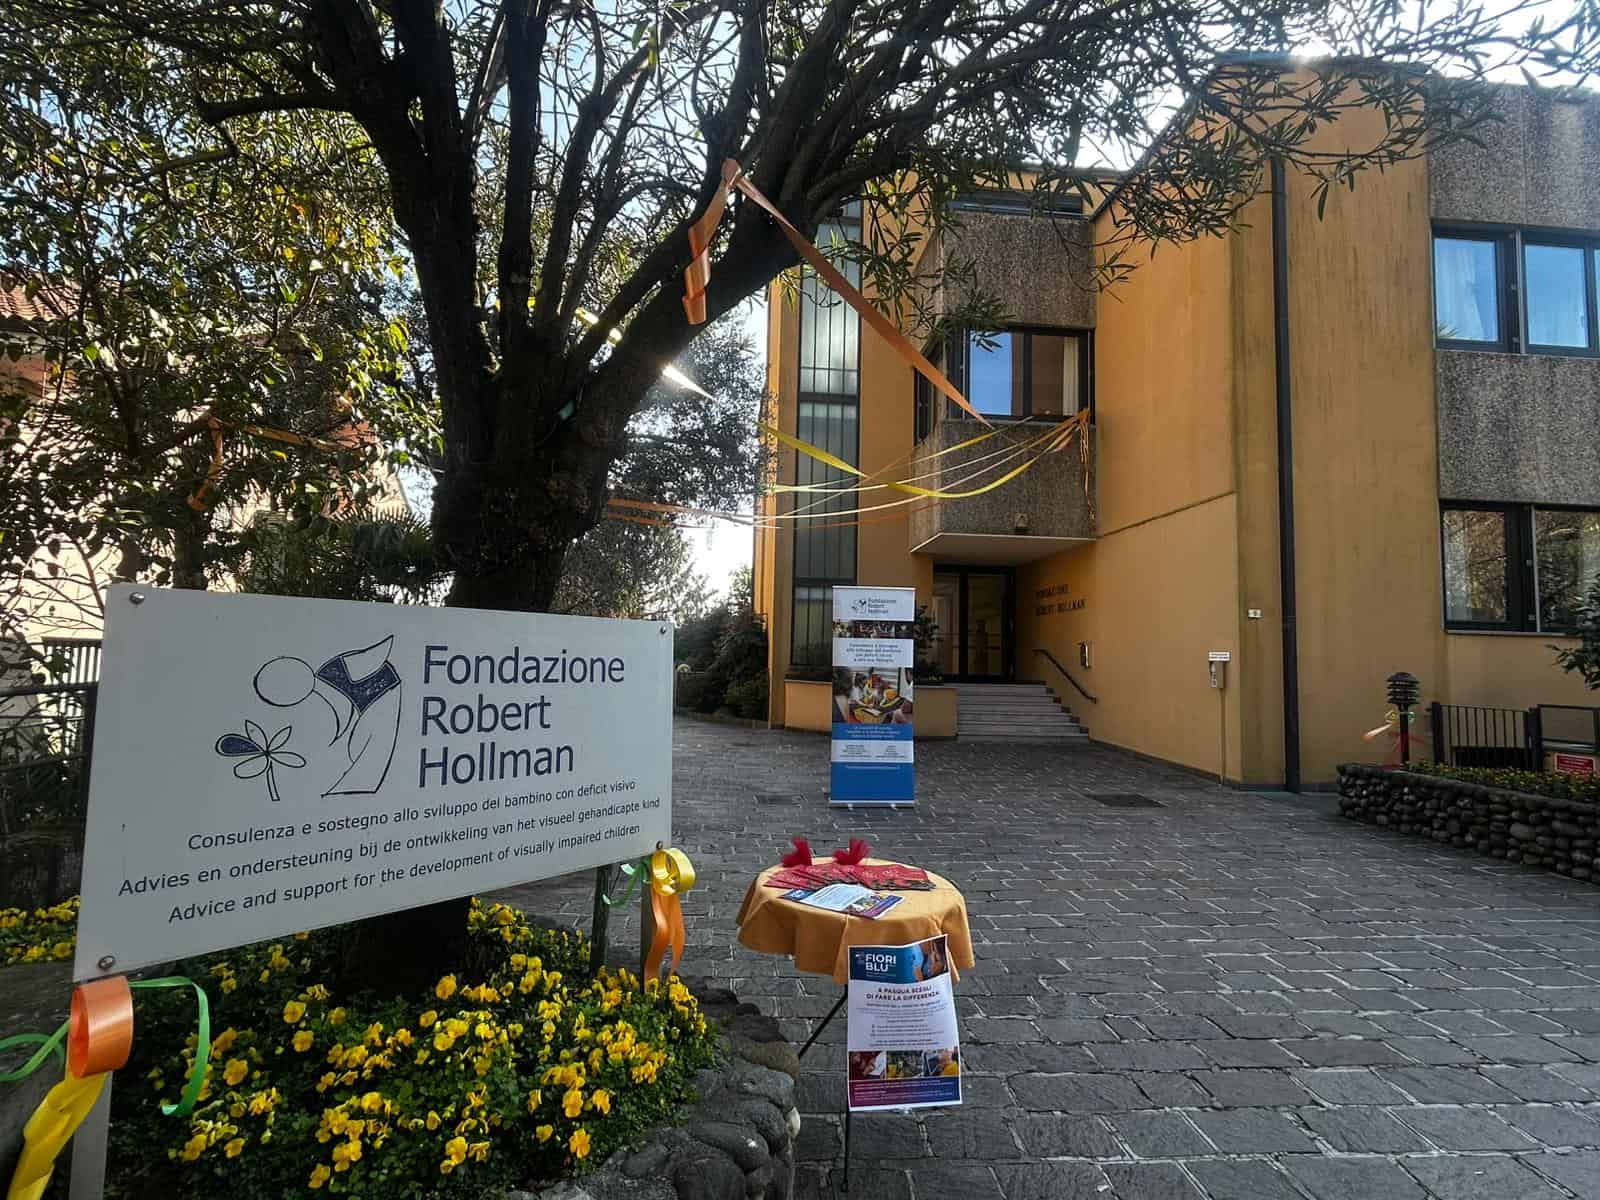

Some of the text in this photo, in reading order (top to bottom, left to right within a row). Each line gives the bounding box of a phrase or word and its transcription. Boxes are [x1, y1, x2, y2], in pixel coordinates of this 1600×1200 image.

[423, 645, 625, 684] Fondazione
[421, 693, 552, 736] Robert
[418, 741, 574, 788] Hollman
[188, 780, 636, 850] Consulenza e sostegno allo sviluppo del bambino con deficit visivo
[118, 798, 660, 896] Advies en ondersteuning bij de ontwikkeling van het visueel gehandicapte kind
[168, 824, 640, 923] Advice and support for the development of visually impaired children
[865, 953, 897, 964] FIORI
[865, 962, 888, 972] BLU
[903, 991, 940, 1001] DIFFERENZA
